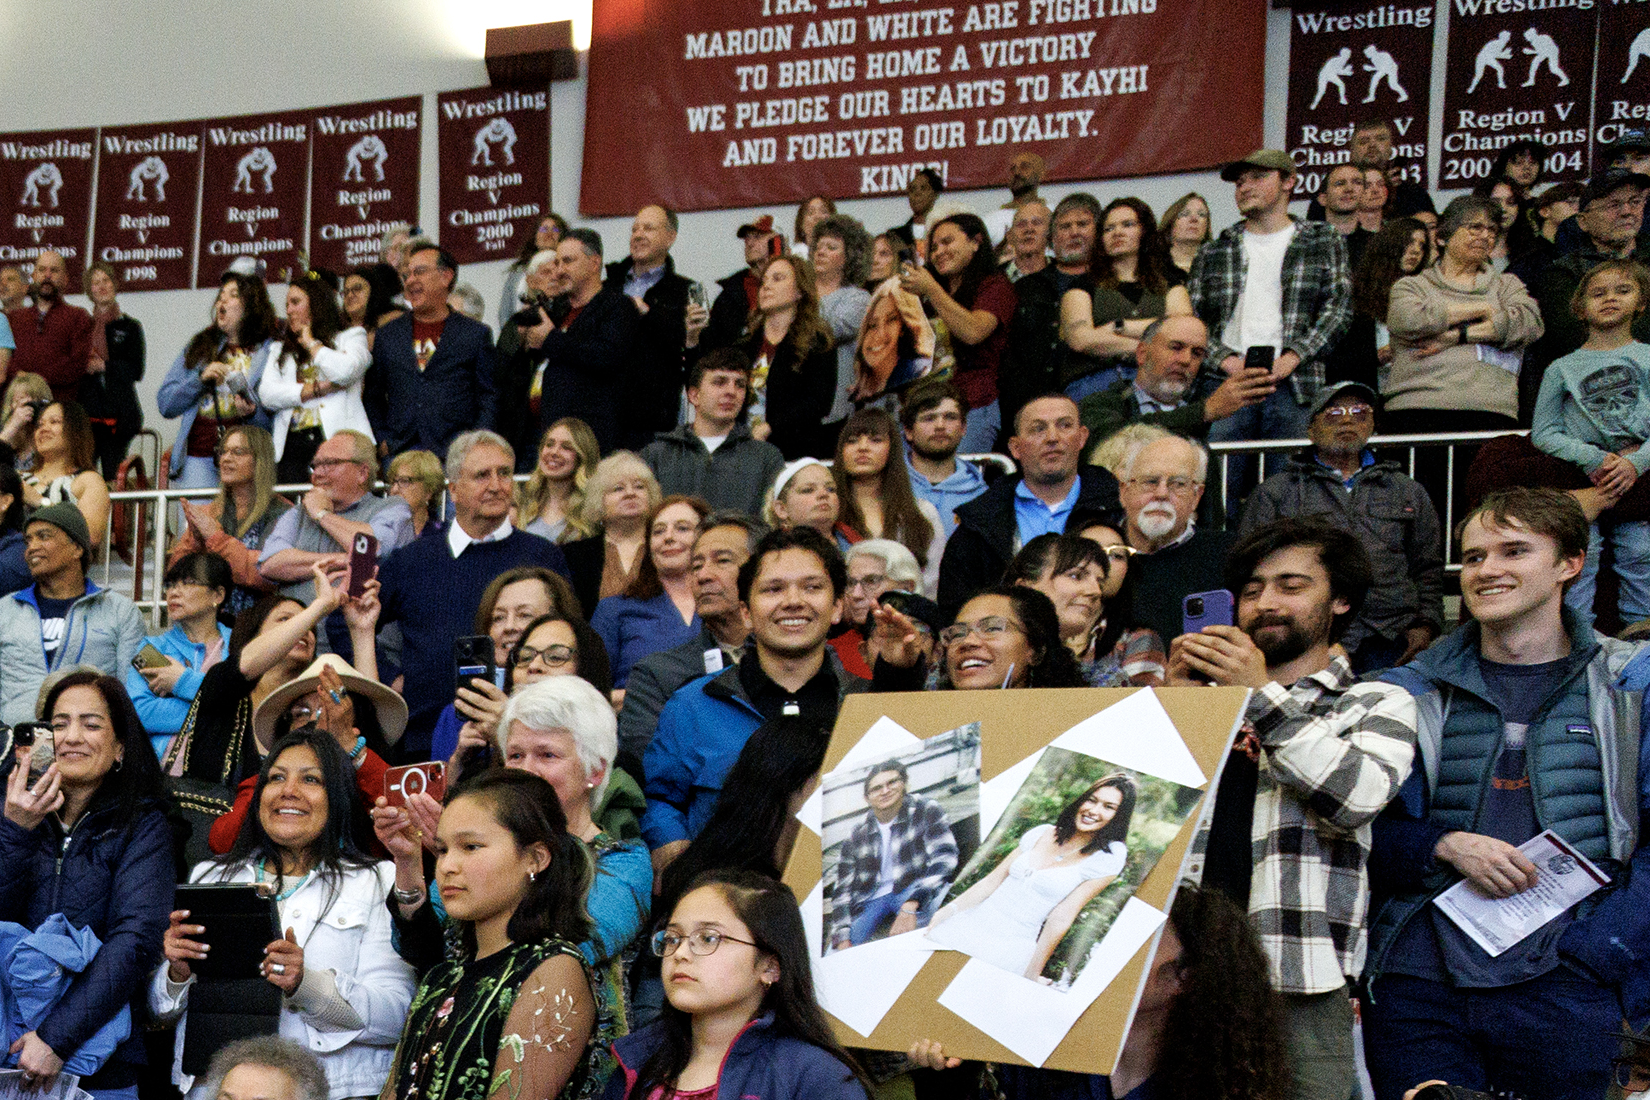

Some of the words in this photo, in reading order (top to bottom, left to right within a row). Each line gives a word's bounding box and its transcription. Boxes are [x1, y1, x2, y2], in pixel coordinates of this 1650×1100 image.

[685, 24, 794, 60] MAROON
[802, 17, 857, 49] AND
[866, 8, 954, 42] WHITE
[962, 1, 1019, 33] ARE
[1028, 0, 1157, 26] FIGHTING
[1296, 5, 1432, 35] Wrestling
[736, 64, 769, 92] TO
[777, 55, 856, 89] BRING
[865, 47, 942, 80] HOME
[950, 44, 971, 72] A
[979, 31, 1097, 69] VICTORY
[442, 91, 548, 120] Wrestling
[686, 104, 726, 133] WE
[735, 95, 830, 130] PLEDGE
[839, 90, 890, 120] OUR
[900, 79, 1006, 115] HEARTS
[1015, 74, 1050, 104] TO
[1059, 64, 1149, 100] KAYHI
[317, 110, 418, 135] Wrestling
[1457, 107, 1545, 131] Region
[1553, 101, 1576, 121] V
[209, 122, 307, 146] Wrestling
[723, 137, 778, 167] AND
[787, 126, 904, 162] FOREVER
[914, 121, 966, 151] OUR
[976, 109, 1099, 146] LOYALTY.
[1301, 121, 1355, 147] Regi
[1393, 116, 1414, 137] V
[1444, 128, 1587, 153] Chamions
[1, 139, 92, 160] Wrestling
[104, 132, 199, 154] Wrestling
[467, 172, 523, 192] Region
[337, 188, 392, 207] Region
[487, 189, 501, 205] V
[15, 213, 64, 229] Region
[119, 213, 171, 230] Region
[227, 205, 279, 223] Region
[357, 204, 370, 220] V
[450, 203, 541, 226] Champions
[33, 228, 44, 243] V
[137, 230, 150, 244] V
[245, 221, 259, 237] V
[476, 222, 515, 243] 2000
[102, 245, 184, 262] Champions
[209, 237, 294, 255] Champions
[346, 238, 381, 257] 2000
[123, 265, 157, 282] 1998
